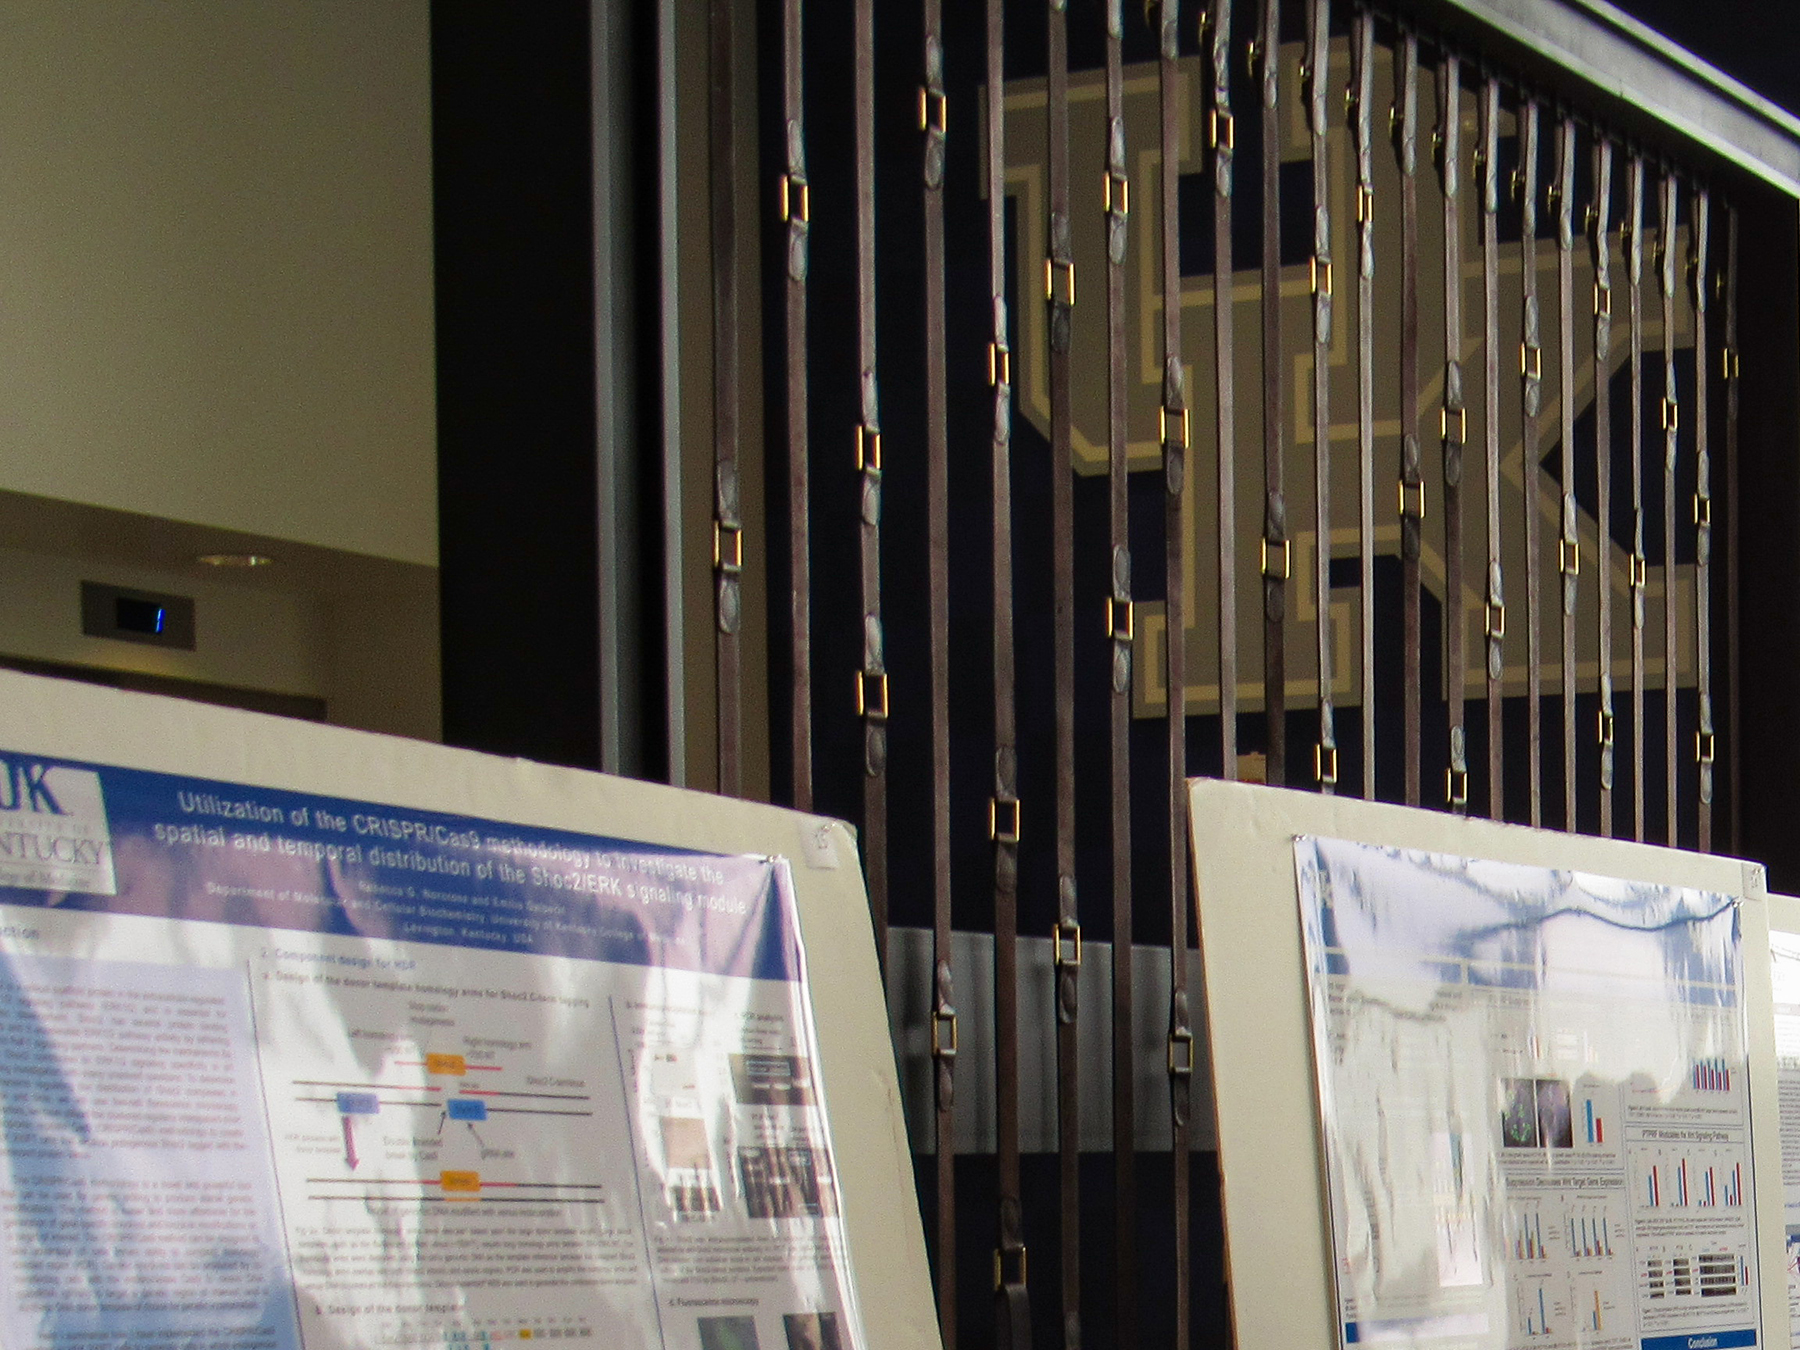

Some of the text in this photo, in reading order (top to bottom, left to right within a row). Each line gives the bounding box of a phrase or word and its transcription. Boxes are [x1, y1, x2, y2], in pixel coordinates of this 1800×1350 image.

[154, 823, 226, 848] spatial
[232, 832, 272, 852] and
[277, 836, 363, 864] temporal
[369, 846, 471, 877] distribution
[477, 861, 496, 879] of
[500, 863, 526, 884] the
[626, 883, 693, 911] signaling
[697, 892, 747, 916] module
[178, 791, 724, 885] Utilization of the CRISPR/Cas9 methodology to investigate the
